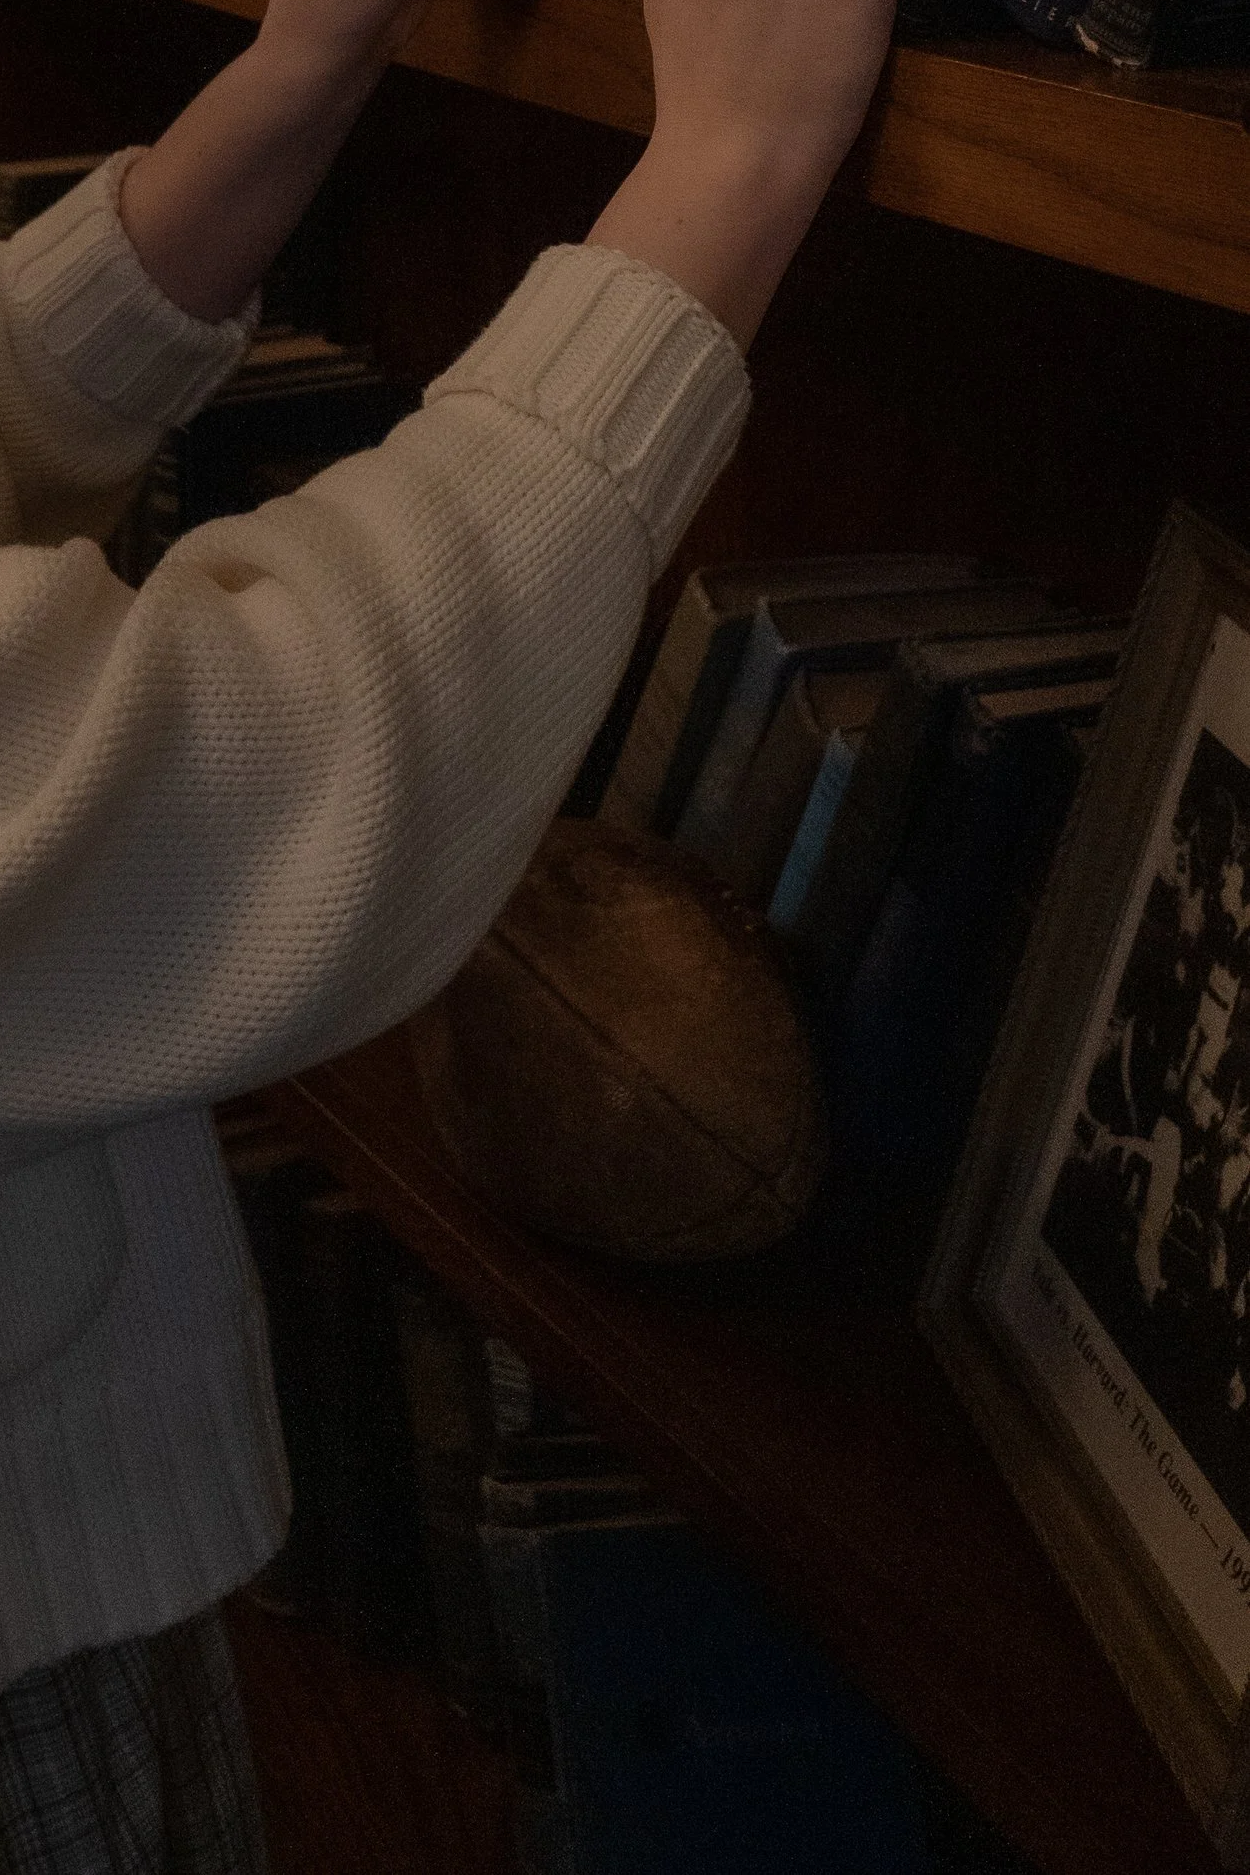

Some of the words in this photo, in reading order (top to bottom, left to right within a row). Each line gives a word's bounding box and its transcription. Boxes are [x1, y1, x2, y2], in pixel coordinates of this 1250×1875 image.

[1071, 1325, 1134, 1414] Harvard:
[1128, 1409, 1159, 1457] The
[1156, 1452, 1201, 1519] Game
[1219, 1545, 1250, 1605] 199
